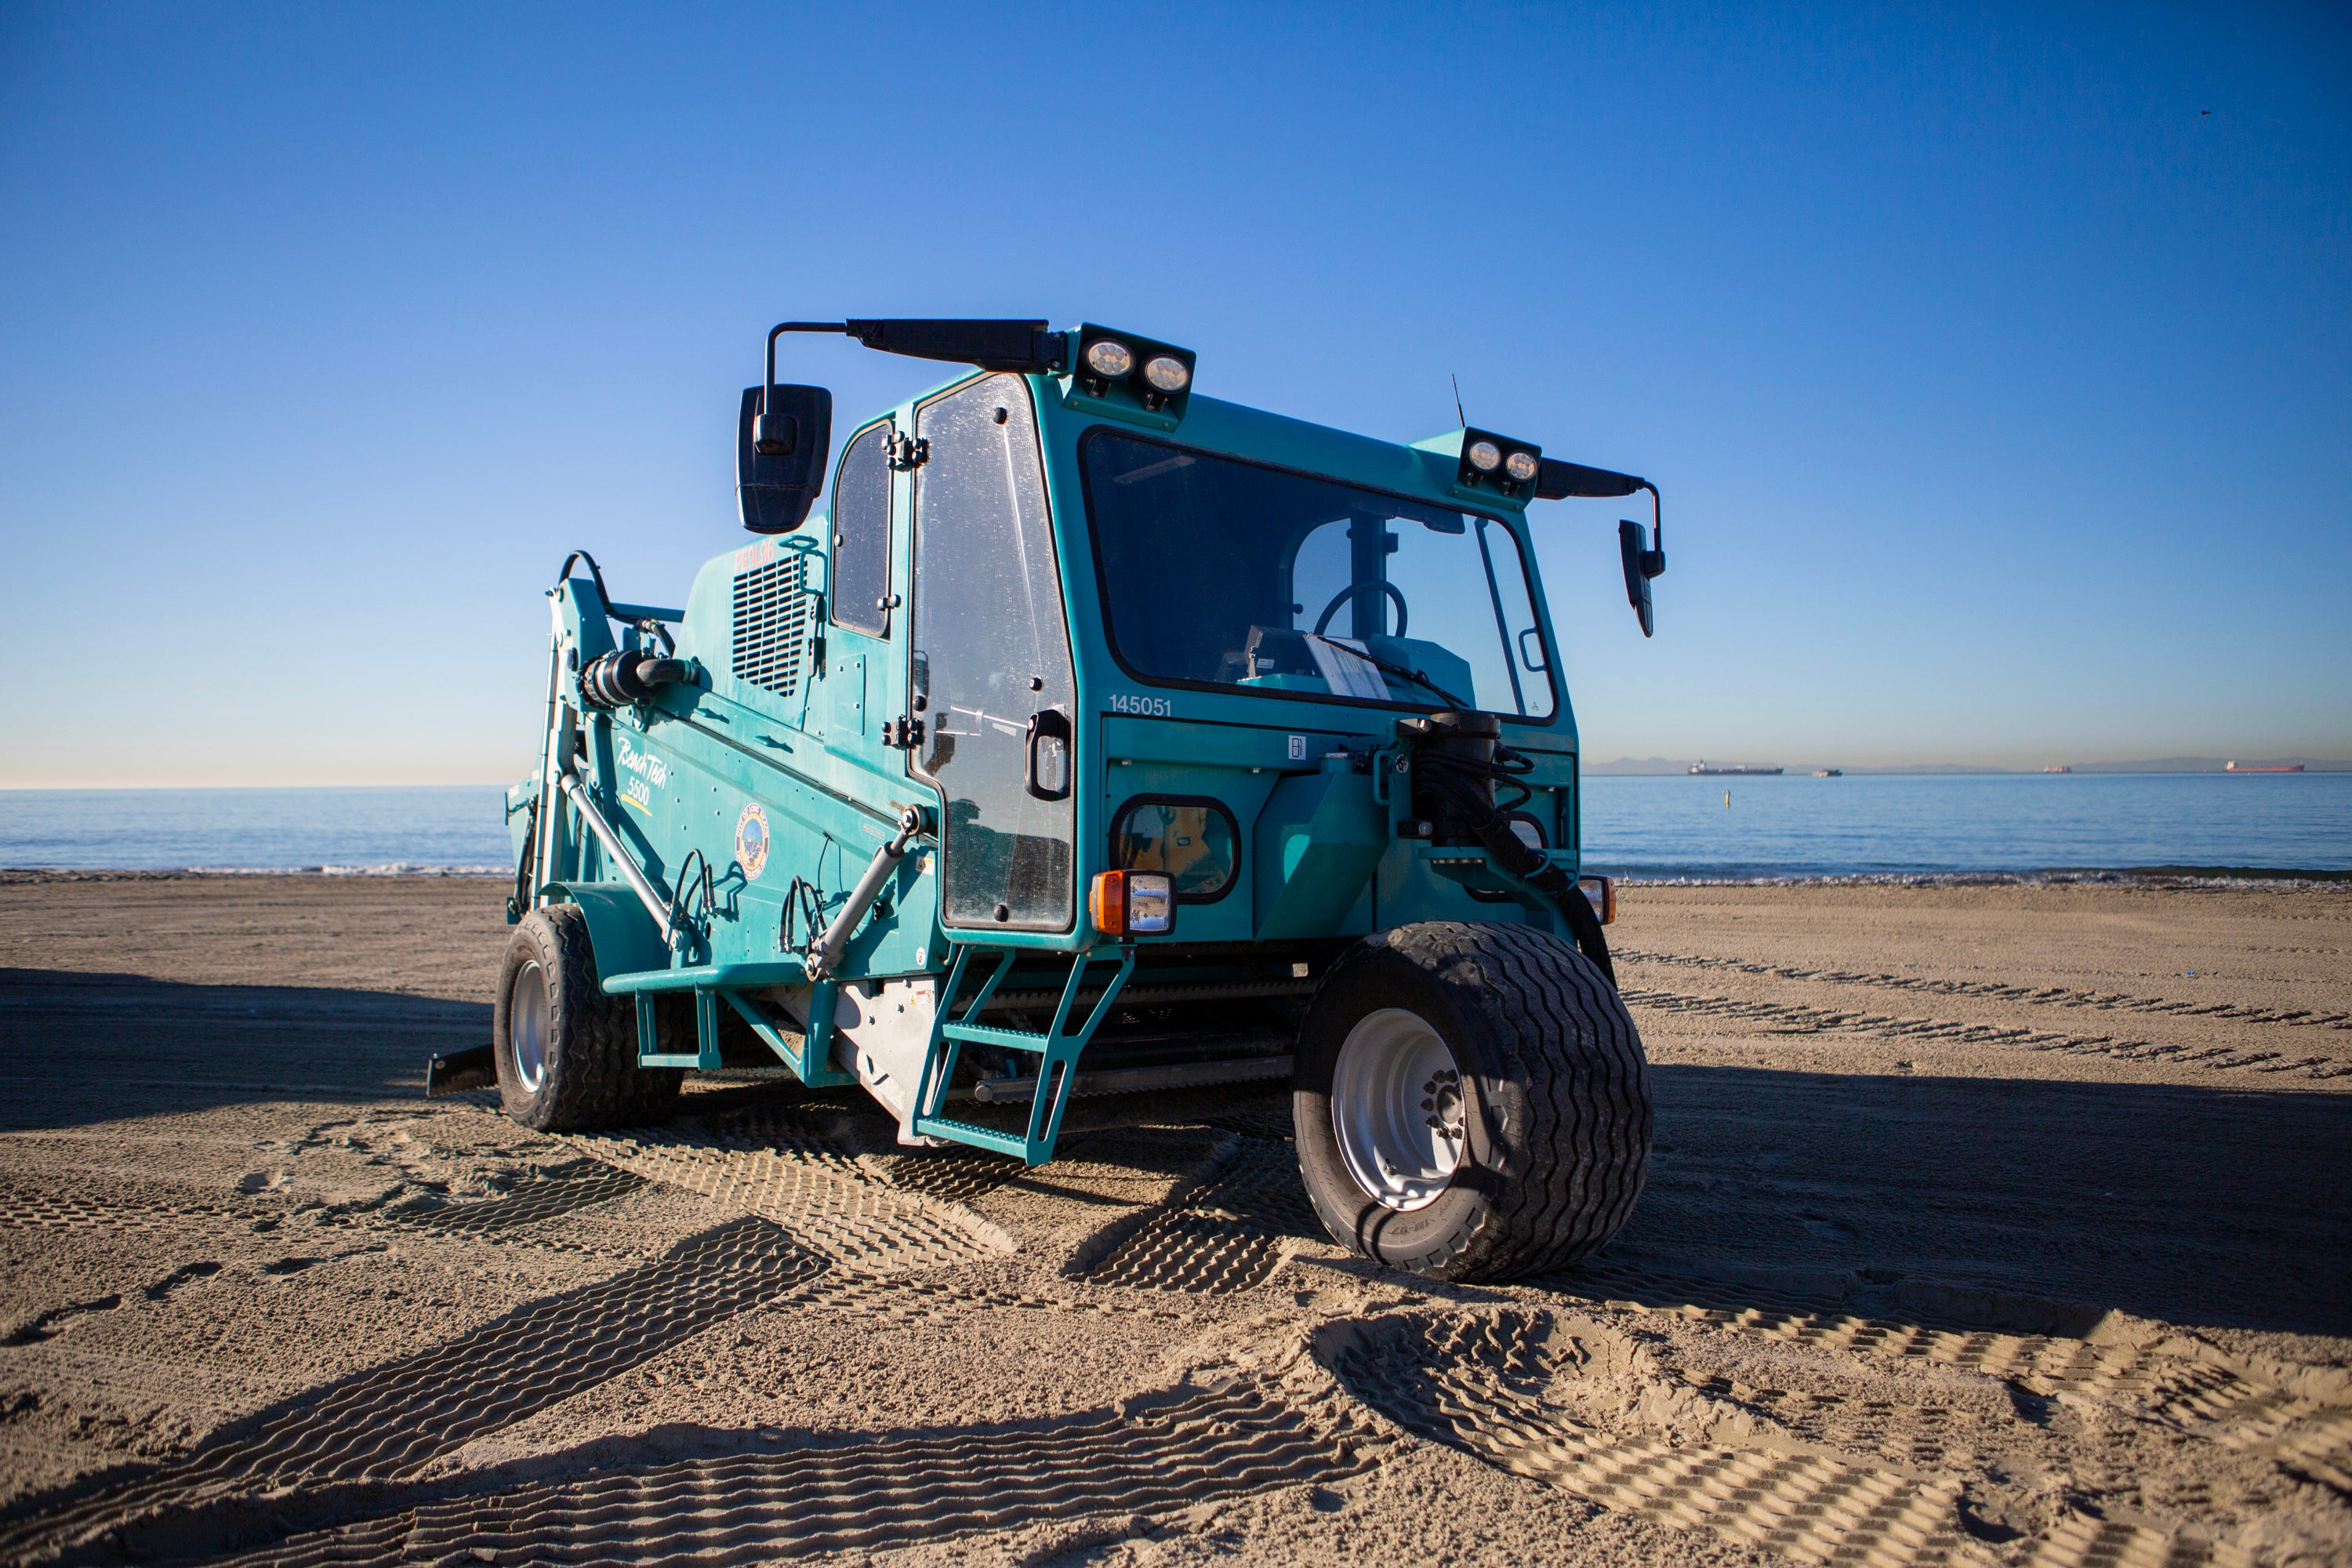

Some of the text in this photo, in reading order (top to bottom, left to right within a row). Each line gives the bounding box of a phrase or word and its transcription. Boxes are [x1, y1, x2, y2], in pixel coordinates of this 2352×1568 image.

[735, 538, 775, 575] PE9L96
[1109, 694, 1171, 717] 145051
[627, 775, 650, 807] 5500
